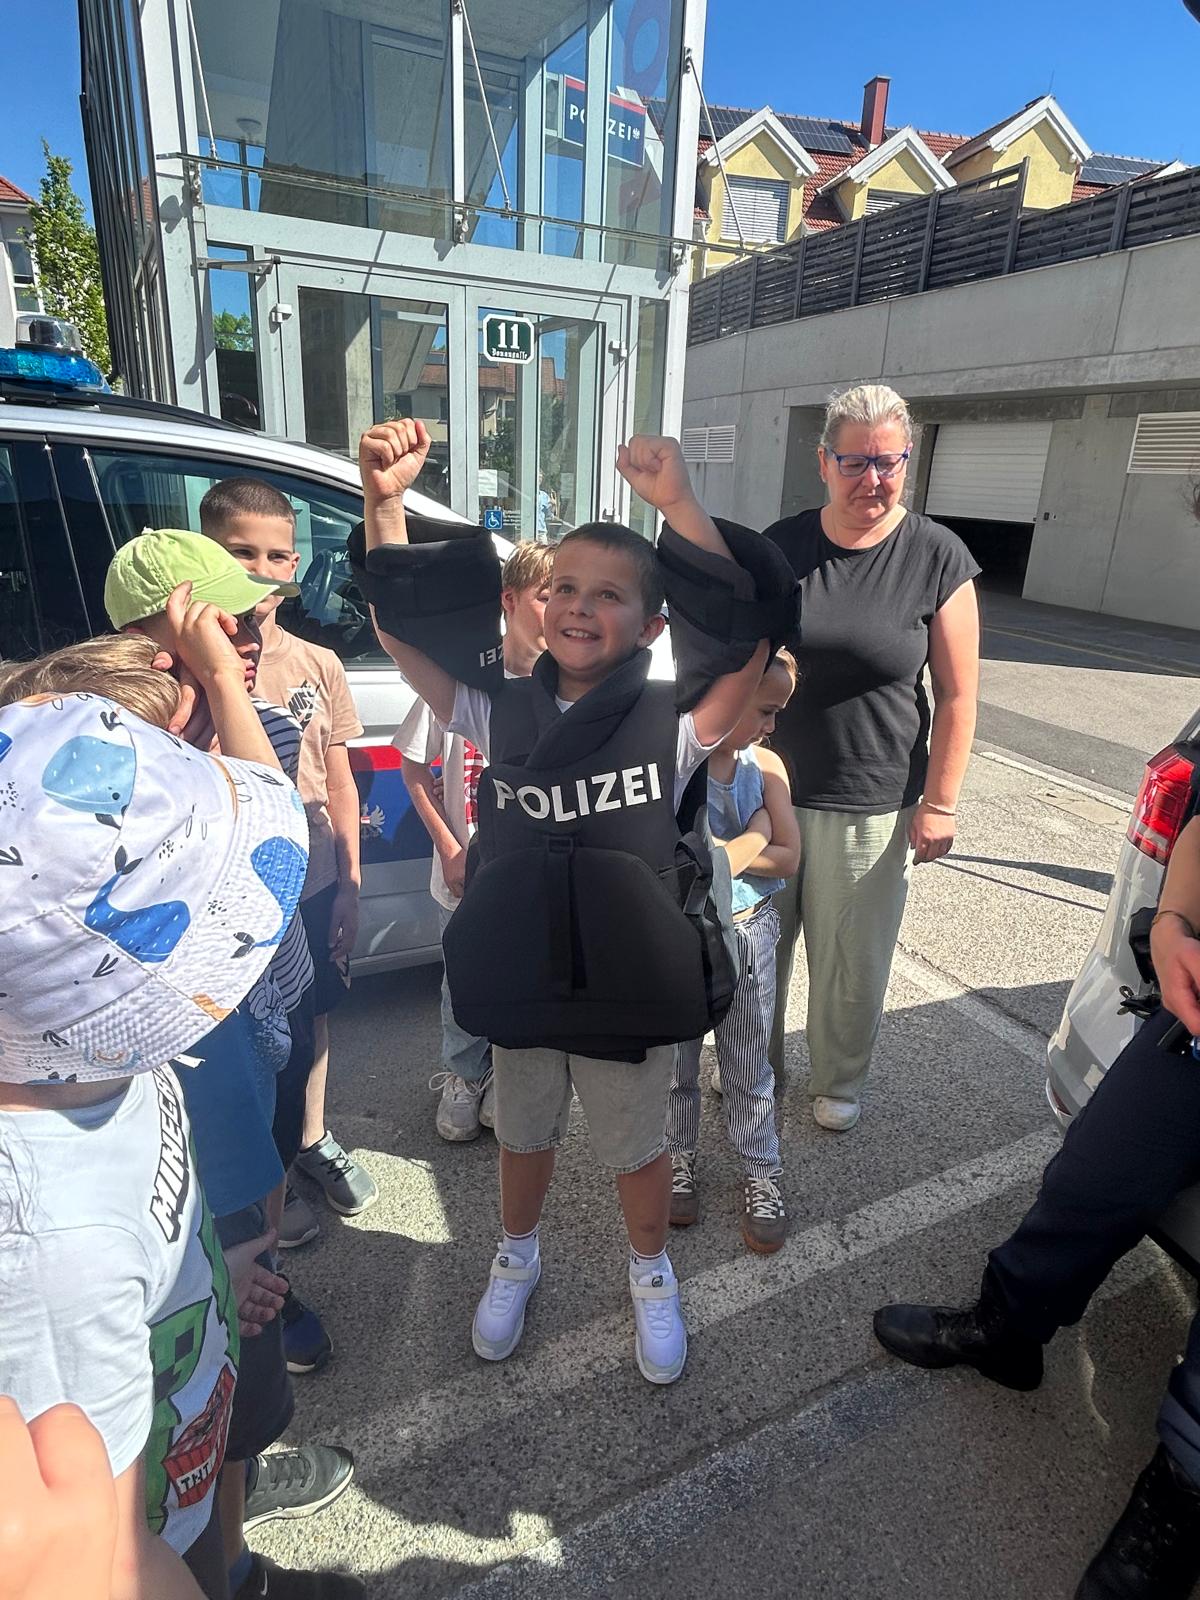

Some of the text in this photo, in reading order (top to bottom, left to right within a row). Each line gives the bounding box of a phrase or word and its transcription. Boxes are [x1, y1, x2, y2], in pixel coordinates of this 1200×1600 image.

[497, 322, 520, 349] 11
[492, 762, 662, 822] POLIZEI
[181, 1462, 211, 1489] TNT
